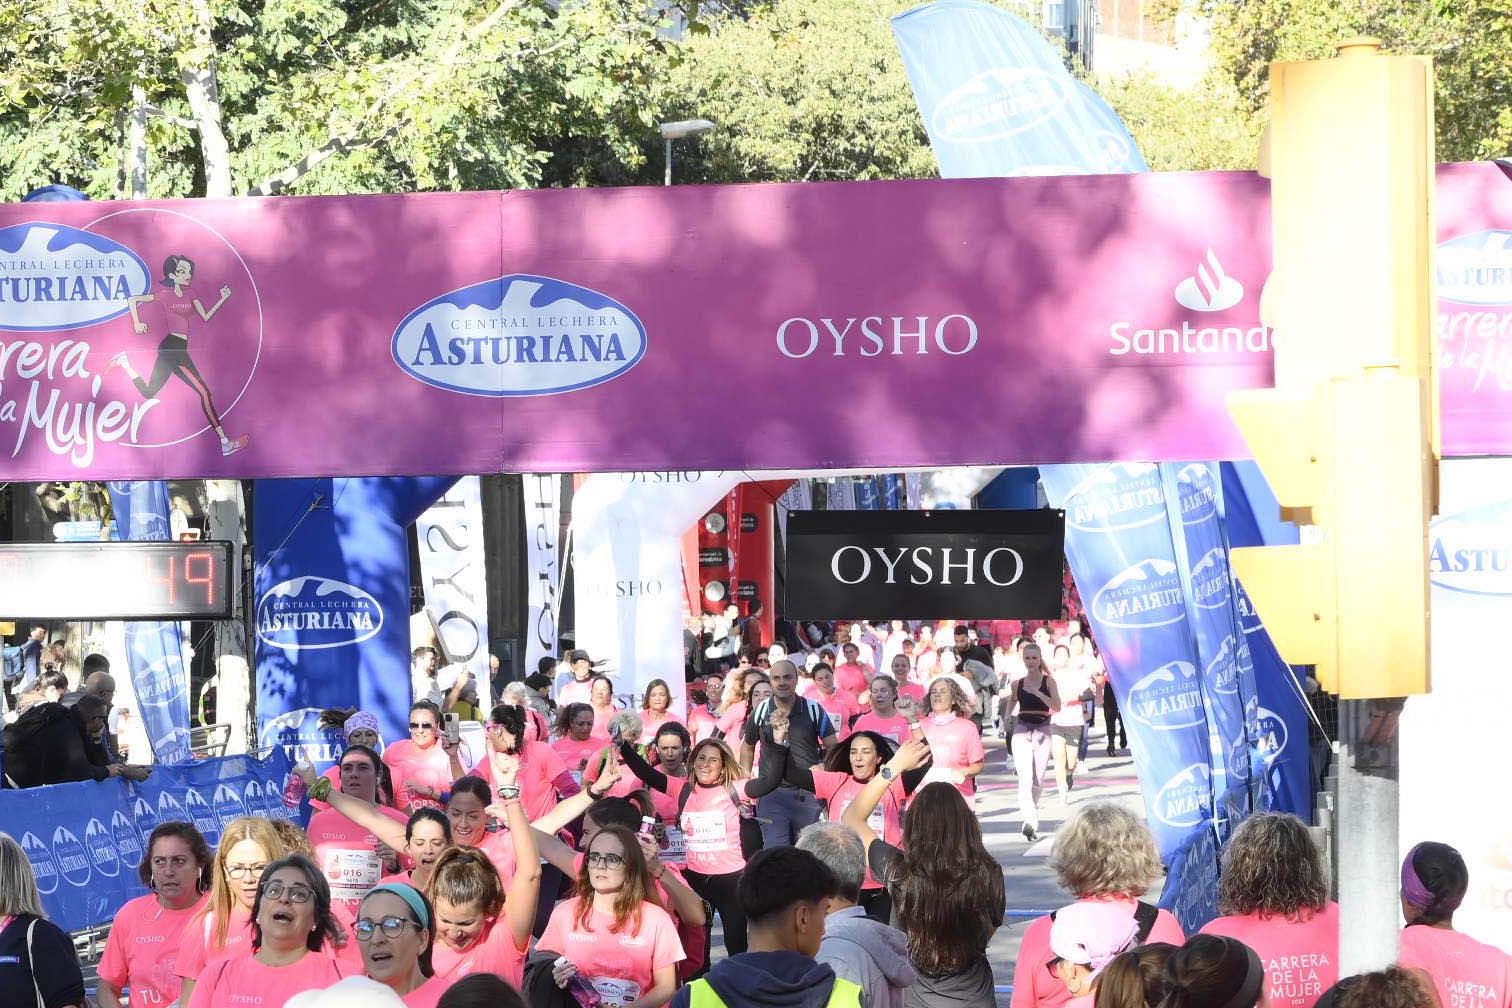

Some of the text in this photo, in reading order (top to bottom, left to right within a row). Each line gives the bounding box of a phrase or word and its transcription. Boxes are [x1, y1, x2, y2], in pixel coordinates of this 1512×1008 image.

[52, 258, 127, 271] LECHERA
[451, 315, 619, 331] CENTRAL LECHERA
[775, 314, 979, 359] OYSHO
[411, 321, 627, 366] ASTURIANA
[1108, 321, 1278, 356] Santand
[11, 373, 161, 469] Mujer
[830, 545, 1025, 586] OYSHO
[1429, 537, 1510, 574] ASTU
[261, 605, 374, 633] ASTURIANA
[1272, 968, 1319, 985] DE LA
[139, 989, 161, 1005] TU
[1269, 982, 1322, 1000] MUJER
[1450, 993, 1467, 1008] DE
